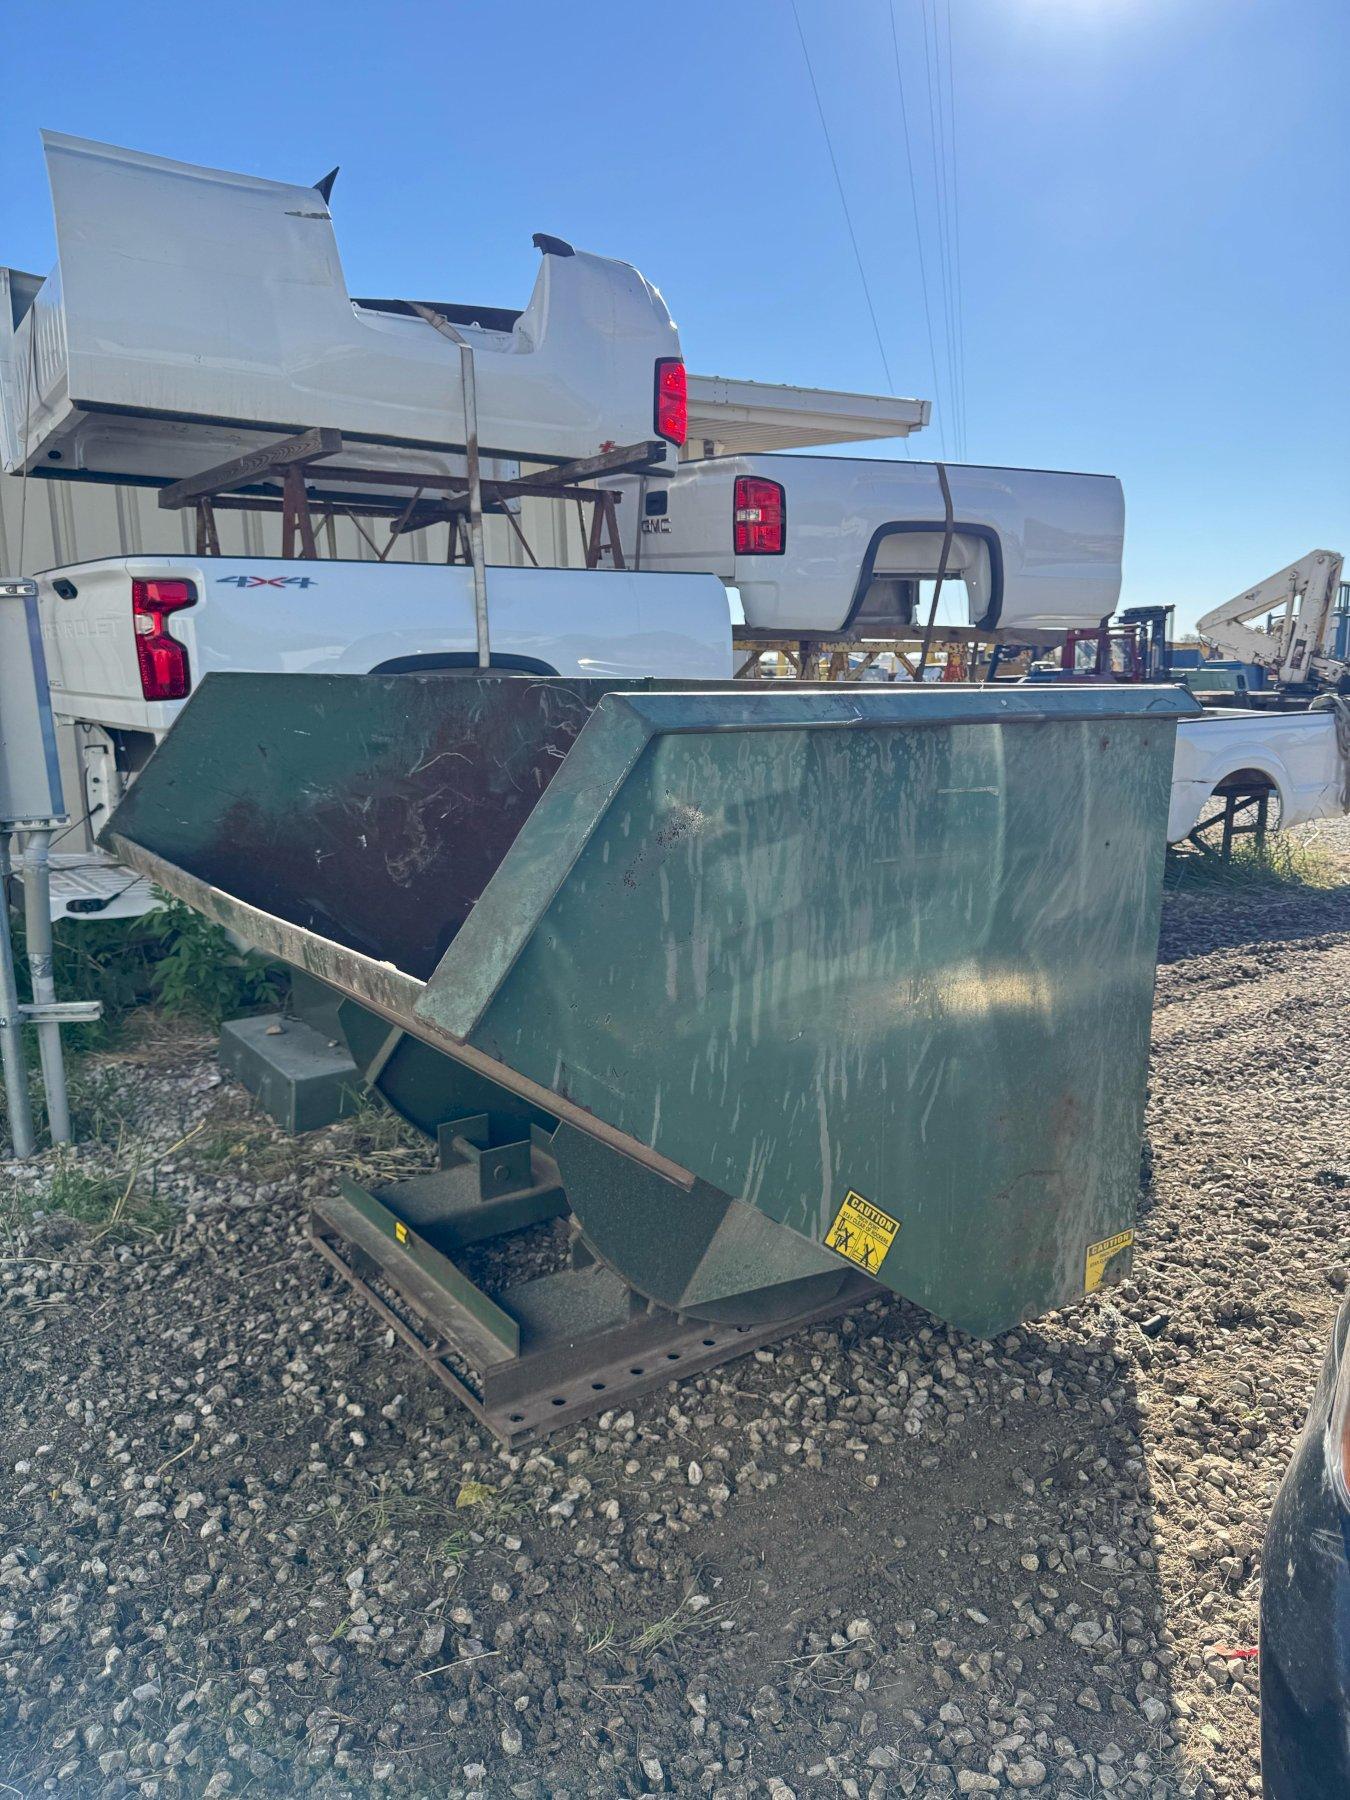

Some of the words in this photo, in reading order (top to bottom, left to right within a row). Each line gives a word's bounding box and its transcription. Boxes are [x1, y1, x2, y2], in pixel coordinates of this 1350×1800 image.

[641, 518, 672, 533] GMC
[41, 617, 121, 640] HEVROLET
[850, 1197, 894, 1232] CAUTION
[1091, 1233, 1129, 1255] CAUTION
